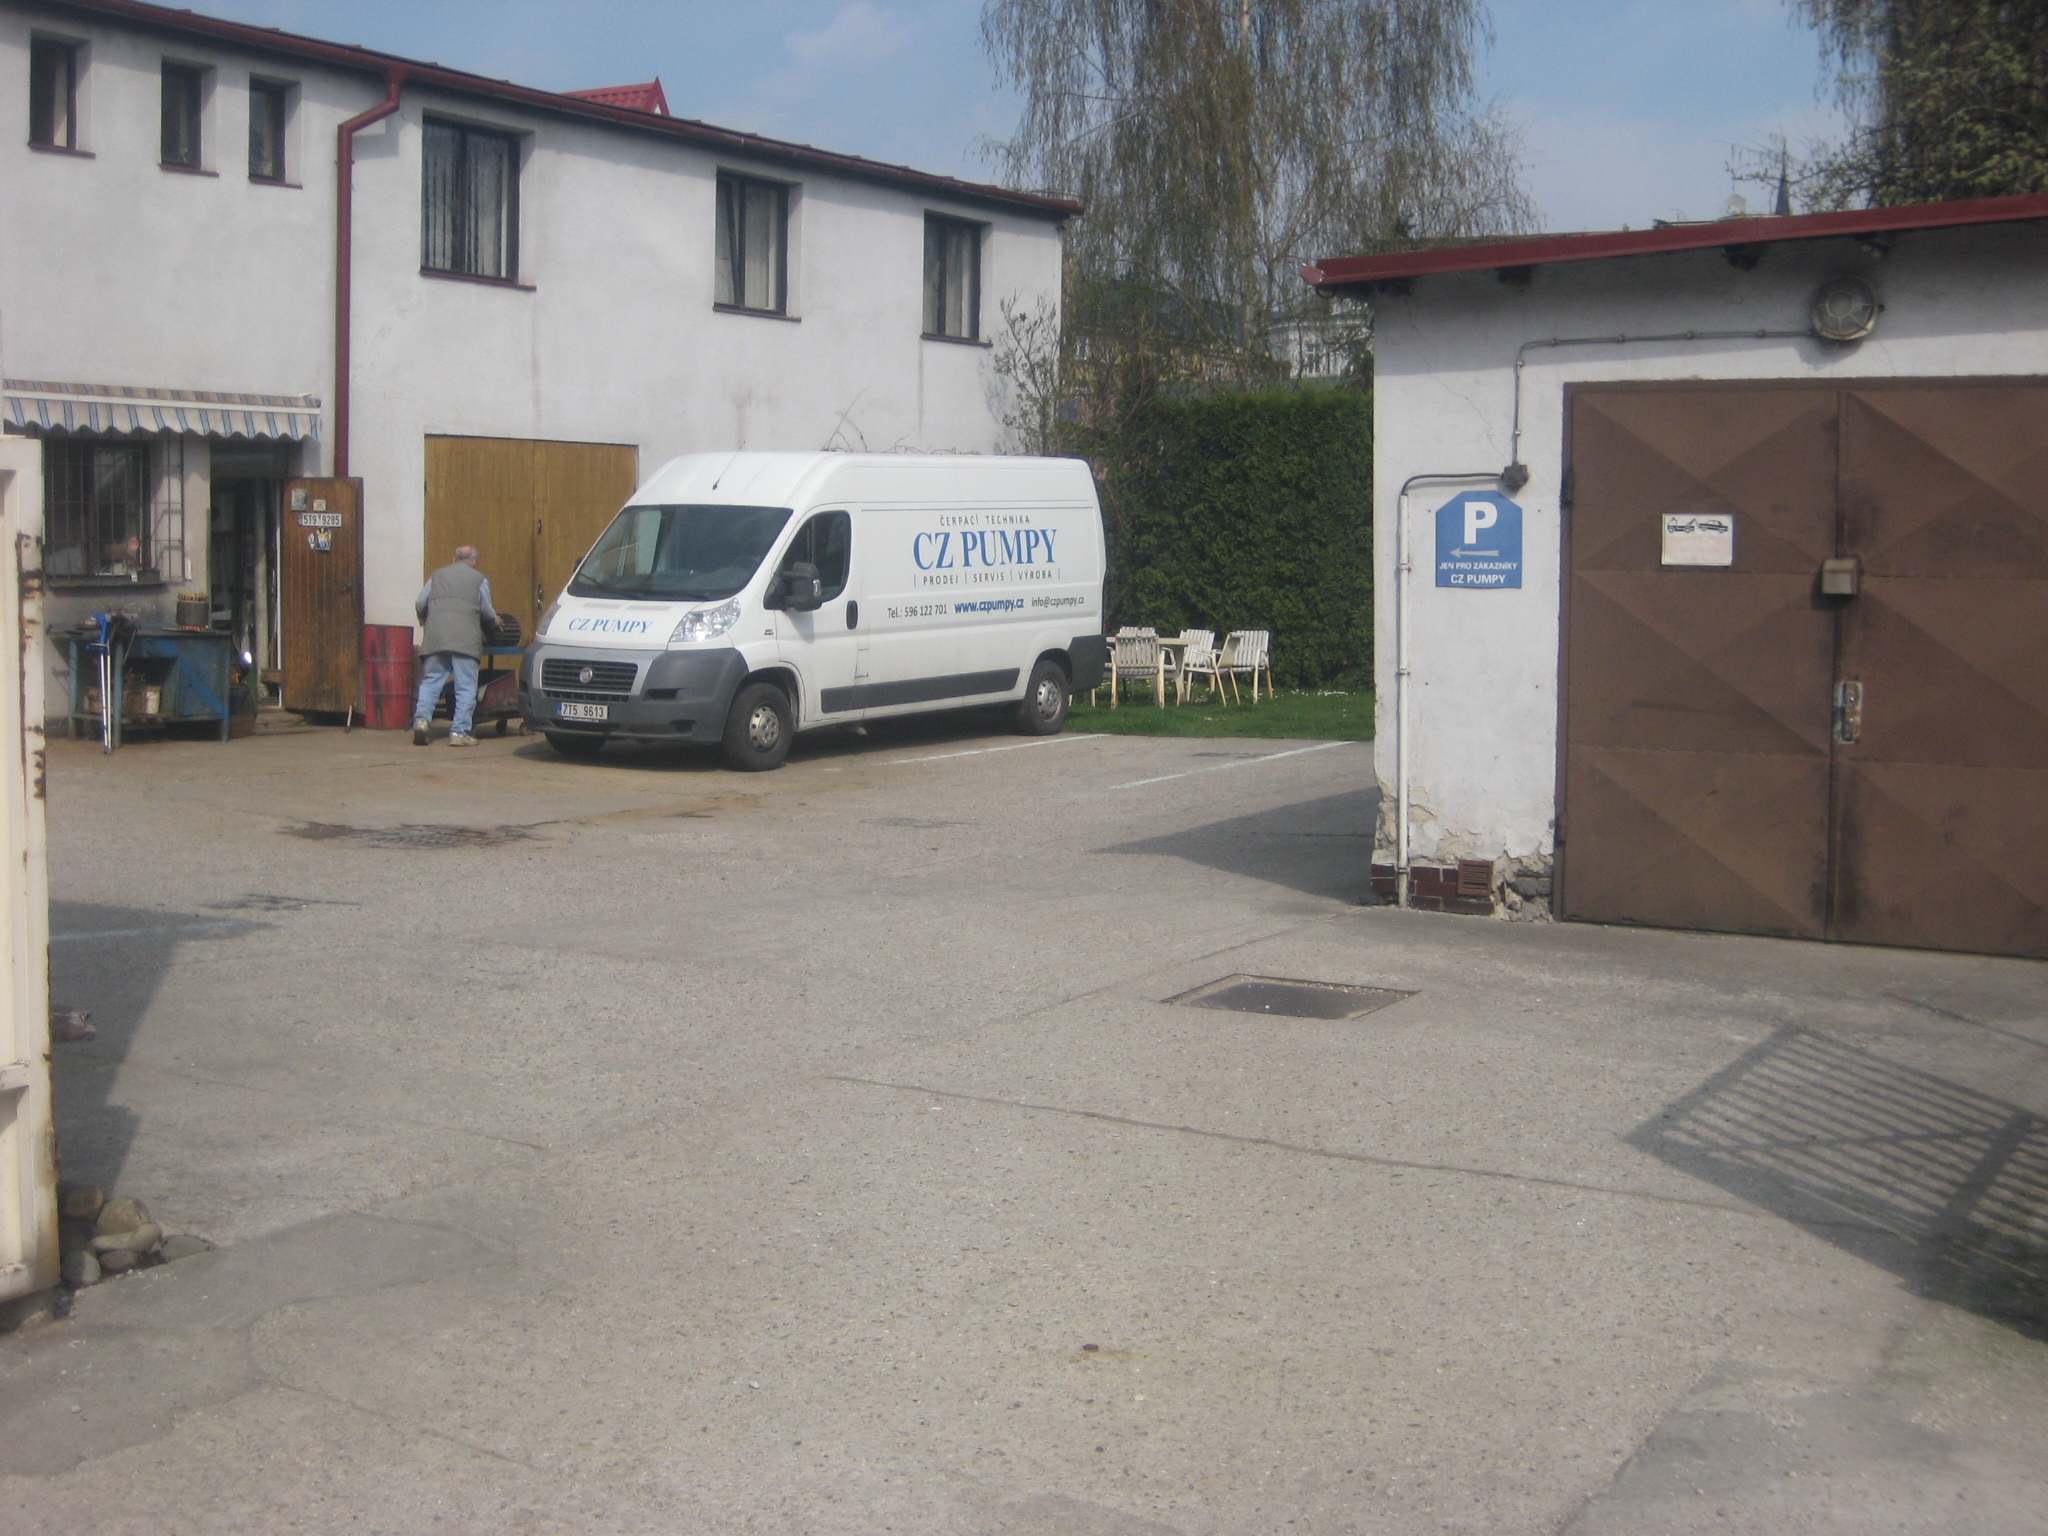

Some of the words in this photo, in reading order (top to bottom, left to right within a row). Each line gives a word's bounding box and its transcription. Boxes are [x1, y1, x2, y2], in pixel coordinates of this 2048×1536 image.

[985, 515, 1031, 525] TECHNIKA
[1464, 501, 1498, 544] P
[913, 532, 954, 570] CZ
[960, 529, 1058, 567] PUMPY
[1439, 562, 1454, 570] JEN
[1456, 562, 1472, 570] PRO
[923, 574, 959, 586] PRODEJ
[973, 572, 1005, 583] SERVIS
[1018, 569, 1053, 580] VÝROBA
[1450, 574, 1464, 584] CZ
[1467, 574, 1506, 584] PUMPY
[887, 606, 903, 619] Tel.:
[904, 605, 918, 617] 596
[919, 605, 933, 616] 122
[934, 604, 948, 615] 701
[954, 598, 1025, 614] www.czpumpy.cz
[1031, 596, 1085, 609] info@czpumpy.cz
[568, 618, 592, 631] CZ
[591, 619, 653, 633] PUMPY
[562, 703, 578, 716] 7T5
[583, 705, 604, 717] 9613
